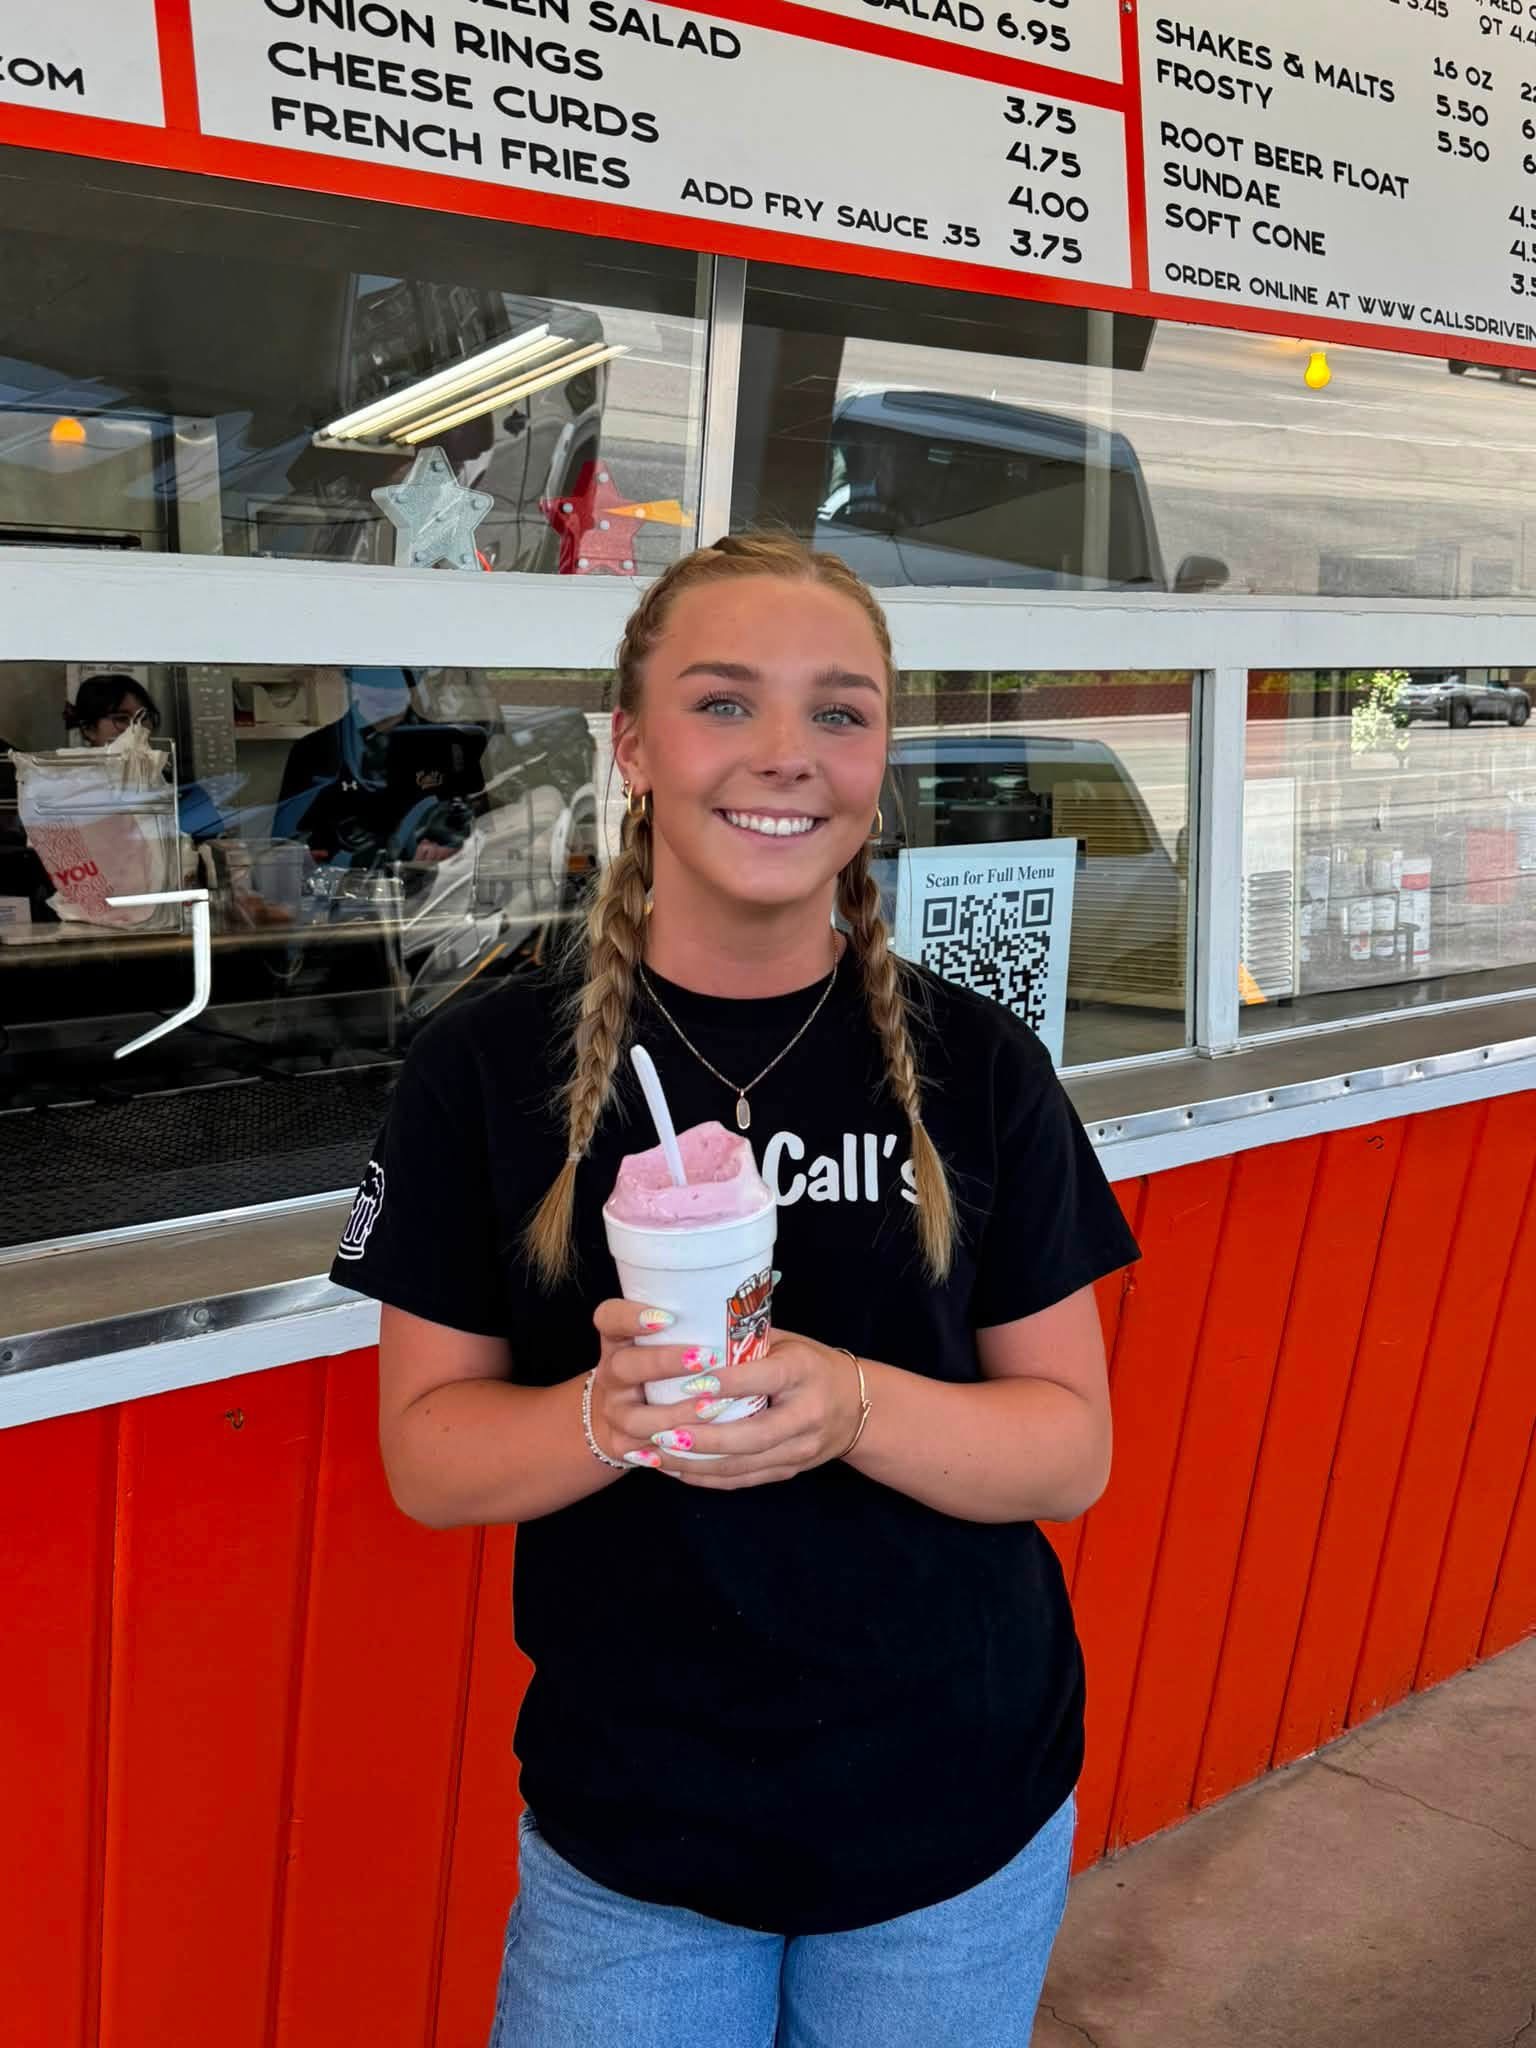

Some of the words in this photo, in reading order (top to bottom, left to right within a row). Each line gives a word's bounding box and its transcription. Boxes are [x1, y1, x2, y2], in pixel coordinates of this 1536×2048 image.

[264, 0, 435, 48] ONION
[455, 22, 603, 81] RINGS
[589, 1, 740, 59] SALAD
[997, 13, 1070, 52] 6.95
[1480, 15, 1502, 35] QT
[0, 56, 85, 95] OM
[1156, 19, 1272, 70] SHAKES
[1284, 52, 1304, 78] &
[1315, 61, 1394, 102] MALTS
[1434, 57, 1457, 79] 16
[1466, 67, 1493, 91] OZ
[268, 42, 473, 109] CHEESE
[494, 86, 659, 143] CURDS
[1157, 59, 1273, 109] FROSTY
[1521, 83, 1536, 103] 2
[1004, 96, 1076, 134] 3.75
[1437, 94, 1488, 126] 5.50
[272, 97, 482, 164] FRENCH
[501, 138, 630, 188] FRIES
[1006, 142, 1081, 178] 4.75
[1161, 121, 1243, 161] ROOT
[1255, 142, 1323, 179] BEER
[1334, 160, 1409, 199] FLOAT
[1438, 131, 1489, 162] 5.50
[1008, 186, 1088, 222] 4.00
[1164, 162, 1280, 208] SUNDAE
[681, 179, 752, 209] ADD
[766, 192, 823, 221] FRY
[838, 206, 928, 239] SAUCE
[943, 224, 980, 247] .35
[1165, 203, 1240, 238] SOFT
[1253, 221, 1325, 256] CONE
[1010, 229, 1082, 263] 3.75
[1166, 263, 1241, 292] ORDER
[1250, 278, 1317, 305] ONLINE
[1326, 291, 1350, 310] AT
[54, 859, 99, 887] YOU
[926, 873, 959, 889] Scan
[963, 870, 984, 886] for
[987, 867, 1014, 884] Full
[1017, 865, 1055, 882] Menu
